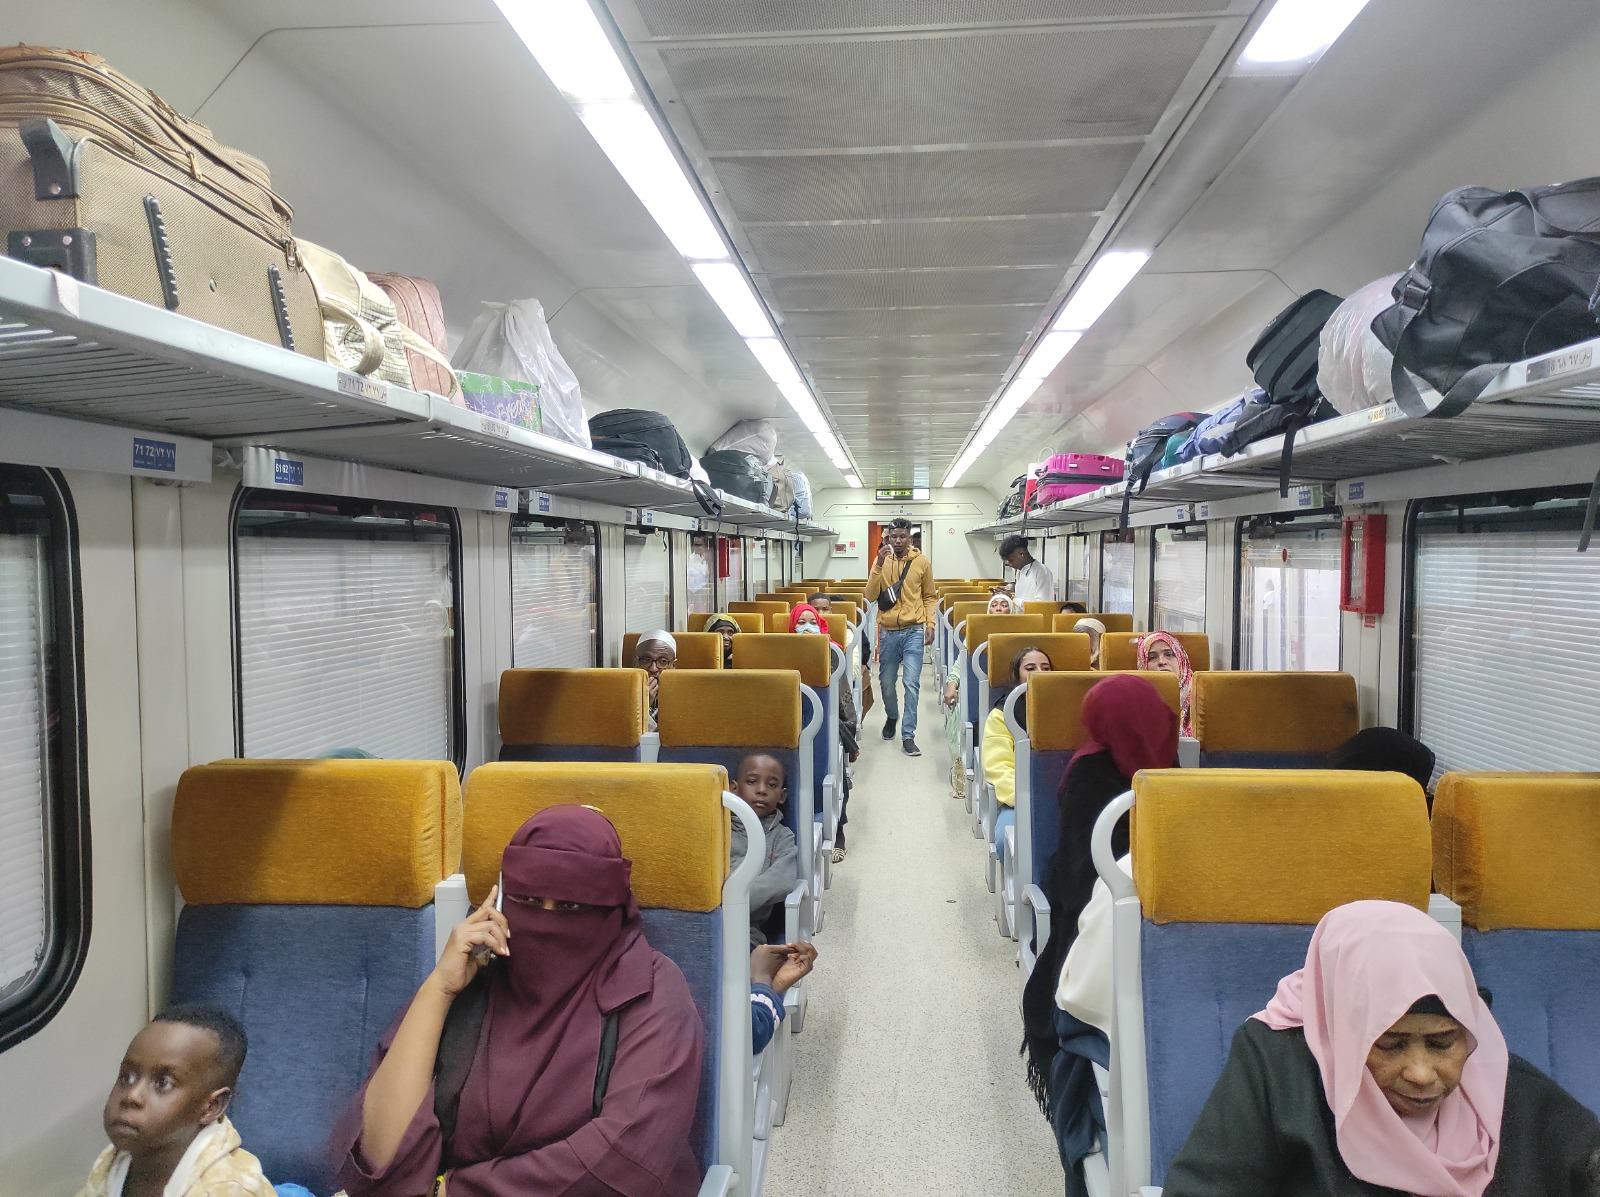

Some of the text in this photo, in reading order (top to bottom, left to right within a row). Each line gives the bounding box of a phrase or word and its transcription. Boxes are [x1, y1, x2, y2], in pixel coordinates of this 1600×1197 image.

[135, 443, 144, 456] 71
[145, 445, 155, 457] 72
[282, 464, 289, 474] 62
